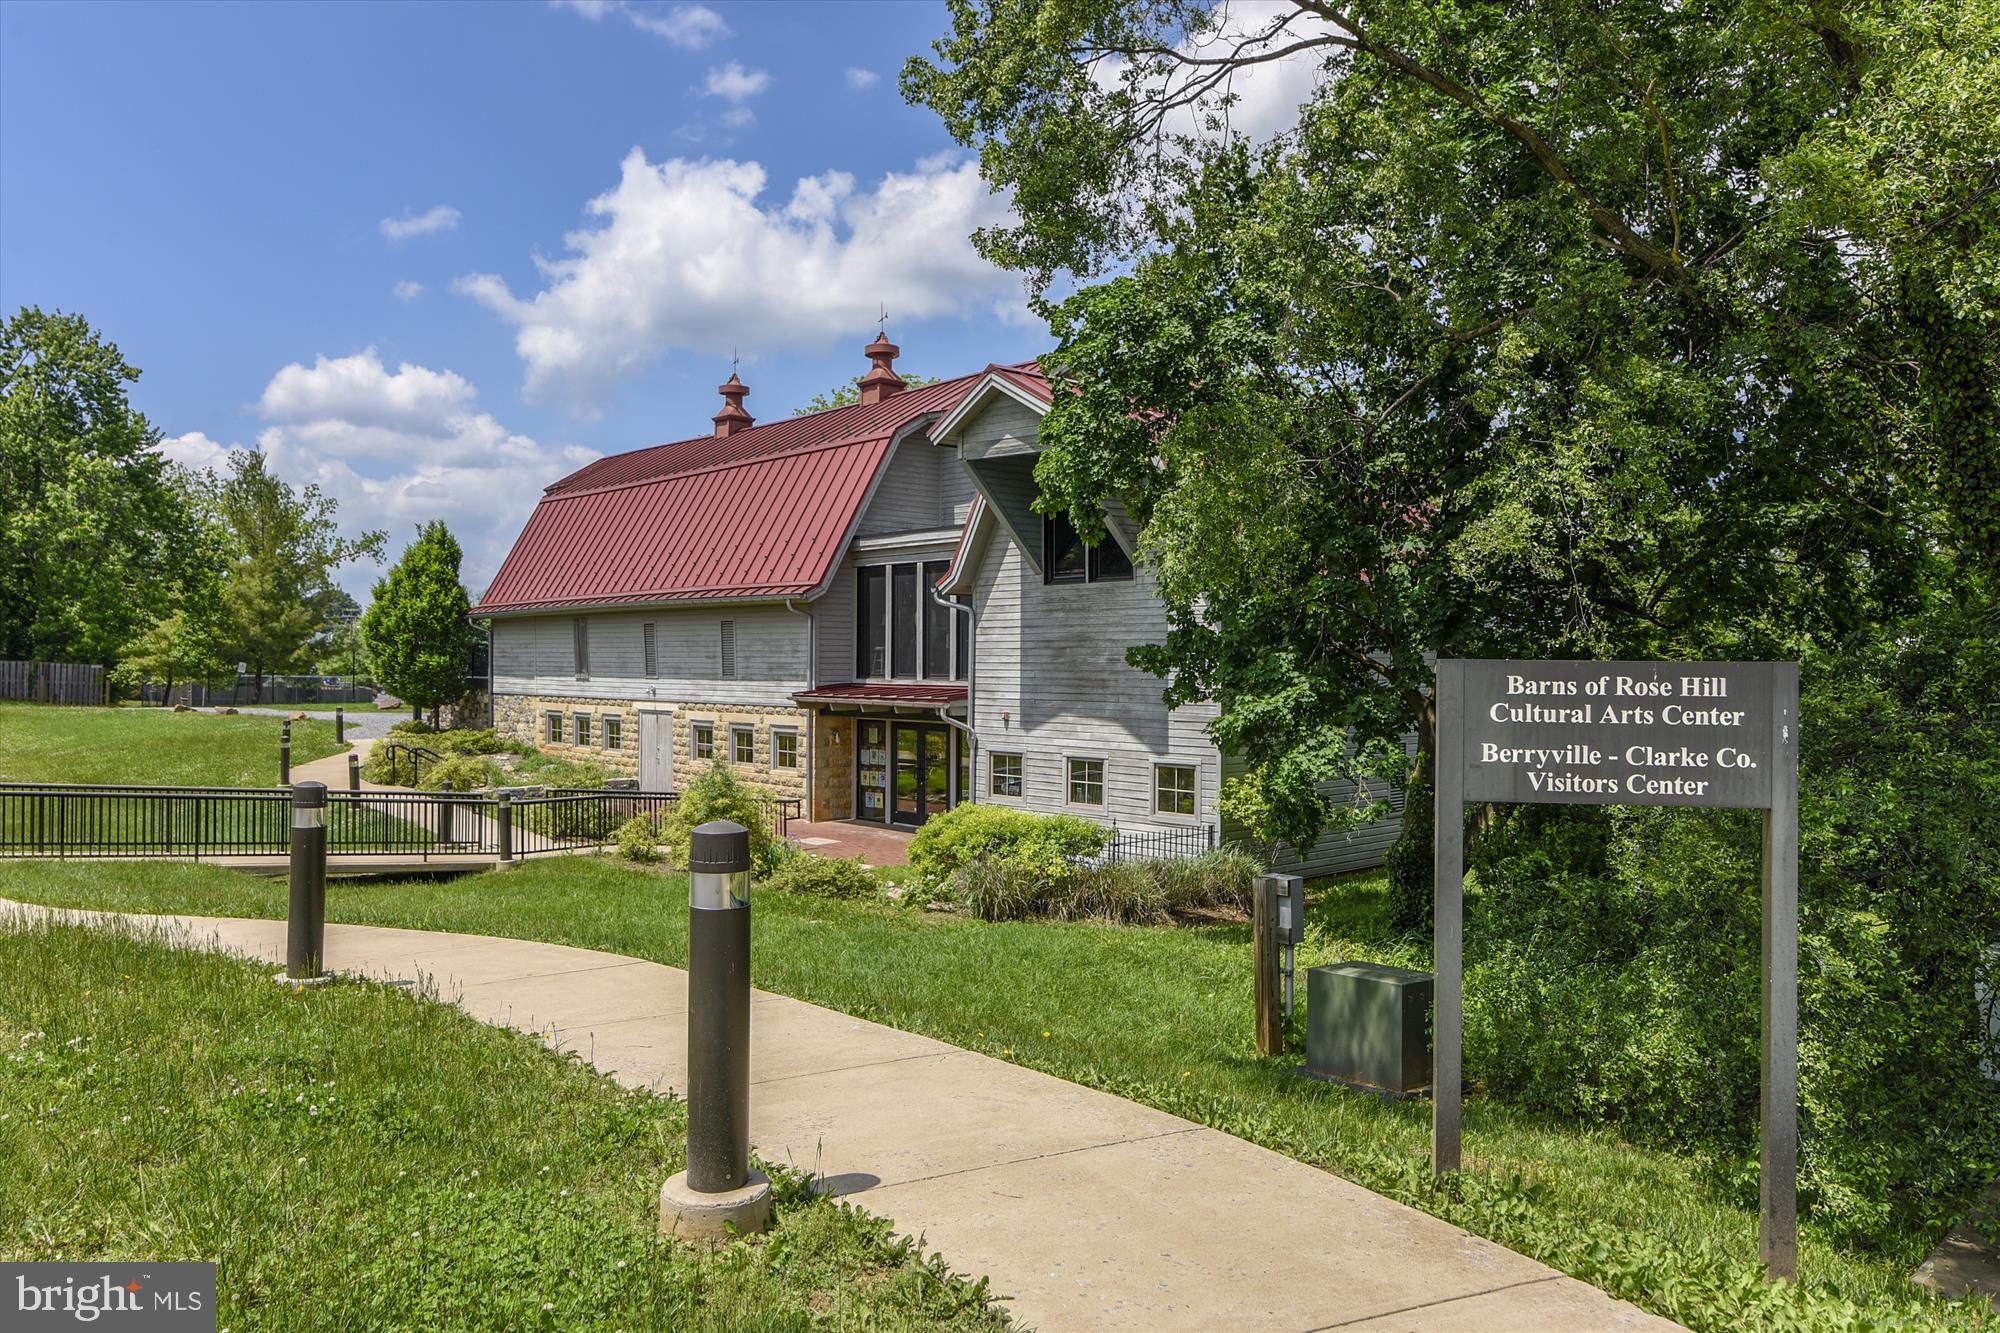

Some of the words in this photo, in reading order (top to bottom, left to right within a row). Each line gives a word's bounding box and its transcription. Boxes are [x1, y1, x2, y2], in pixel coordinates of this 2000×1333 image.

[1506, 675, 1577, 696] Barns
[1585, 675, 1610, 696] of
[1614, 676, 1673, 697] Rose
[1679, 677, 1728, 698] Hill
[1489, 702, 1592, 724] Cultural
[1599, 704, 1654, 725] Arts
[1661, 704, 1745, 726] Center
[1480, 742, 1602, 769] Berryville
[1625, 745, 1709, 768] Clarke
[1716, 747, 1757, 769] Co.
[1526, 771, 1619, 794] Visitors
[1626, 774, 1709, 796] Center
